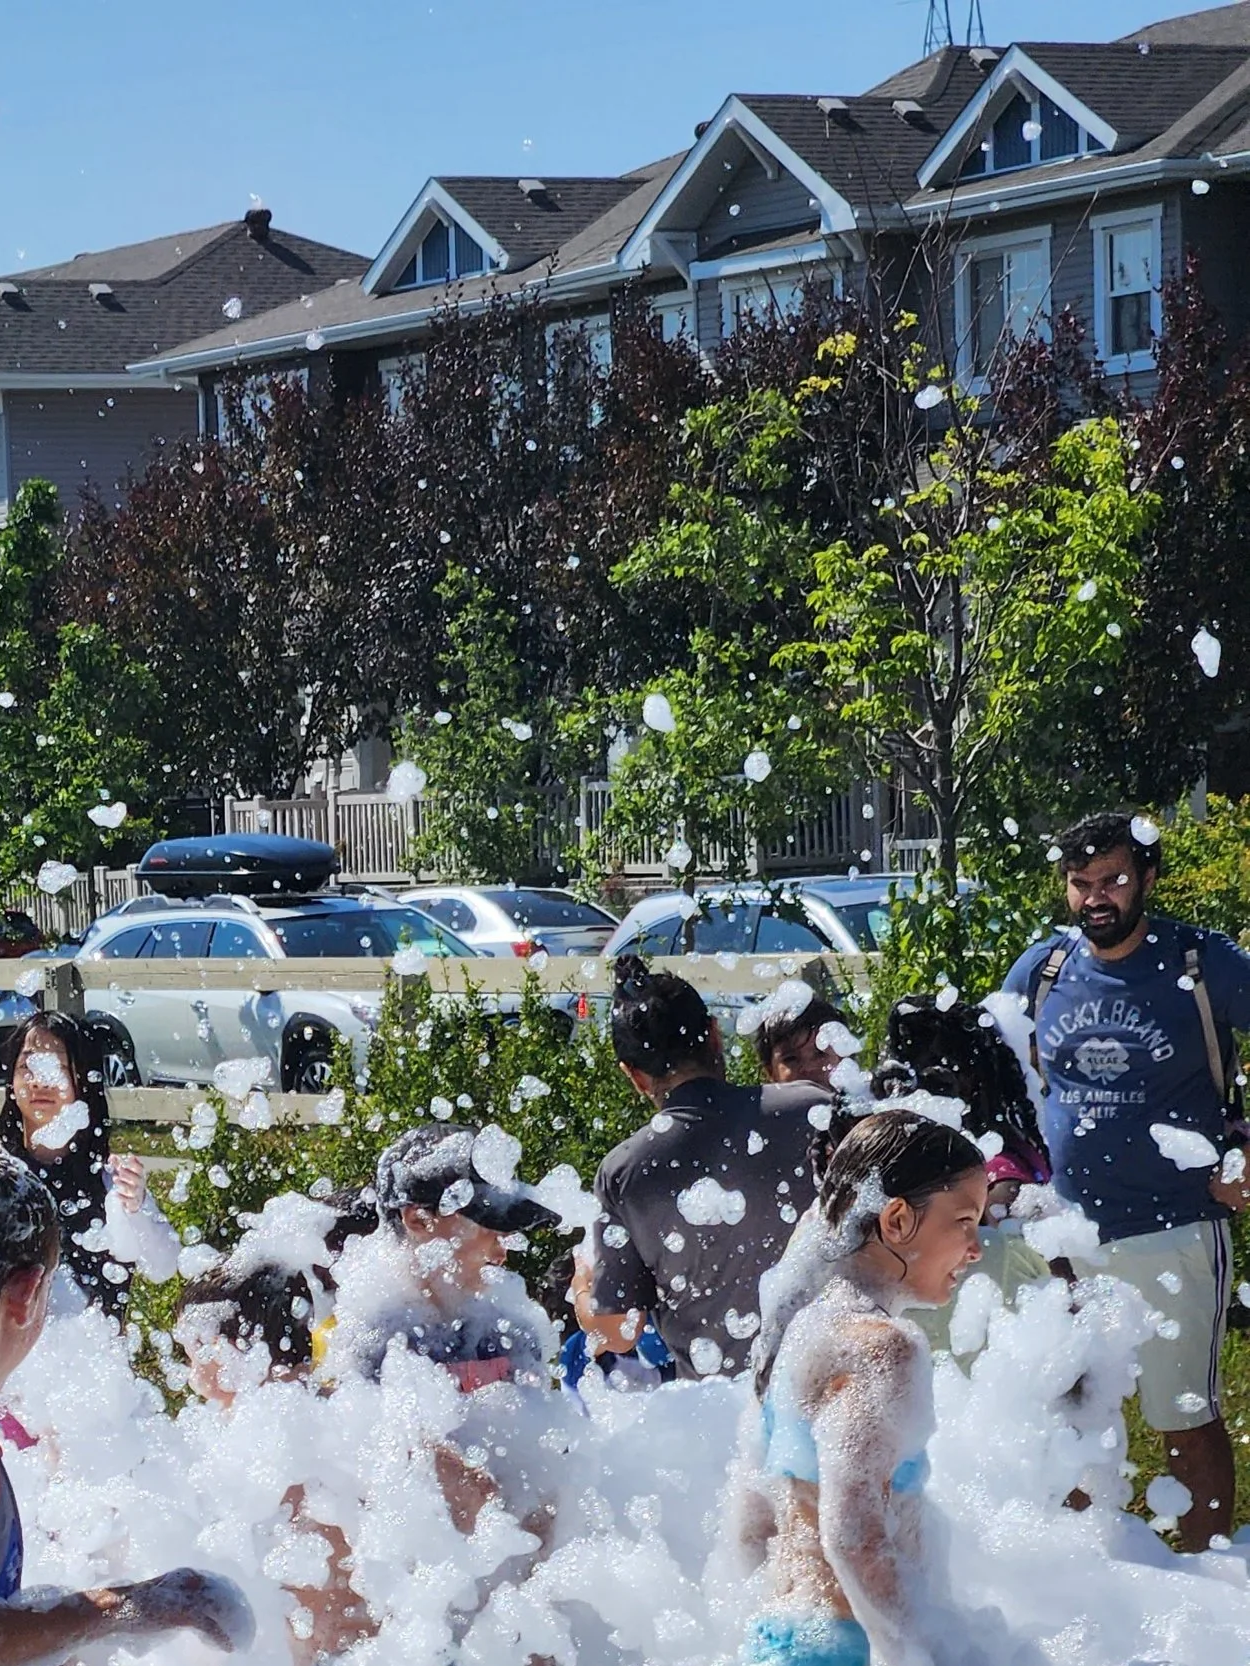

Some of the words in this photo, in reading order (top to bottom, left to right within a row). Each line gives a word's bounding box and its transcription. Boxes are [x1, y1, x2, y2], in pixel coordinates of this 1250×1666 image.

[1040, 1000, 1103, 1062] LUCKY
[1111, 1000, 1174, 1062] BRAND
[1084, 1090, 1146, 1104] ANGELES
